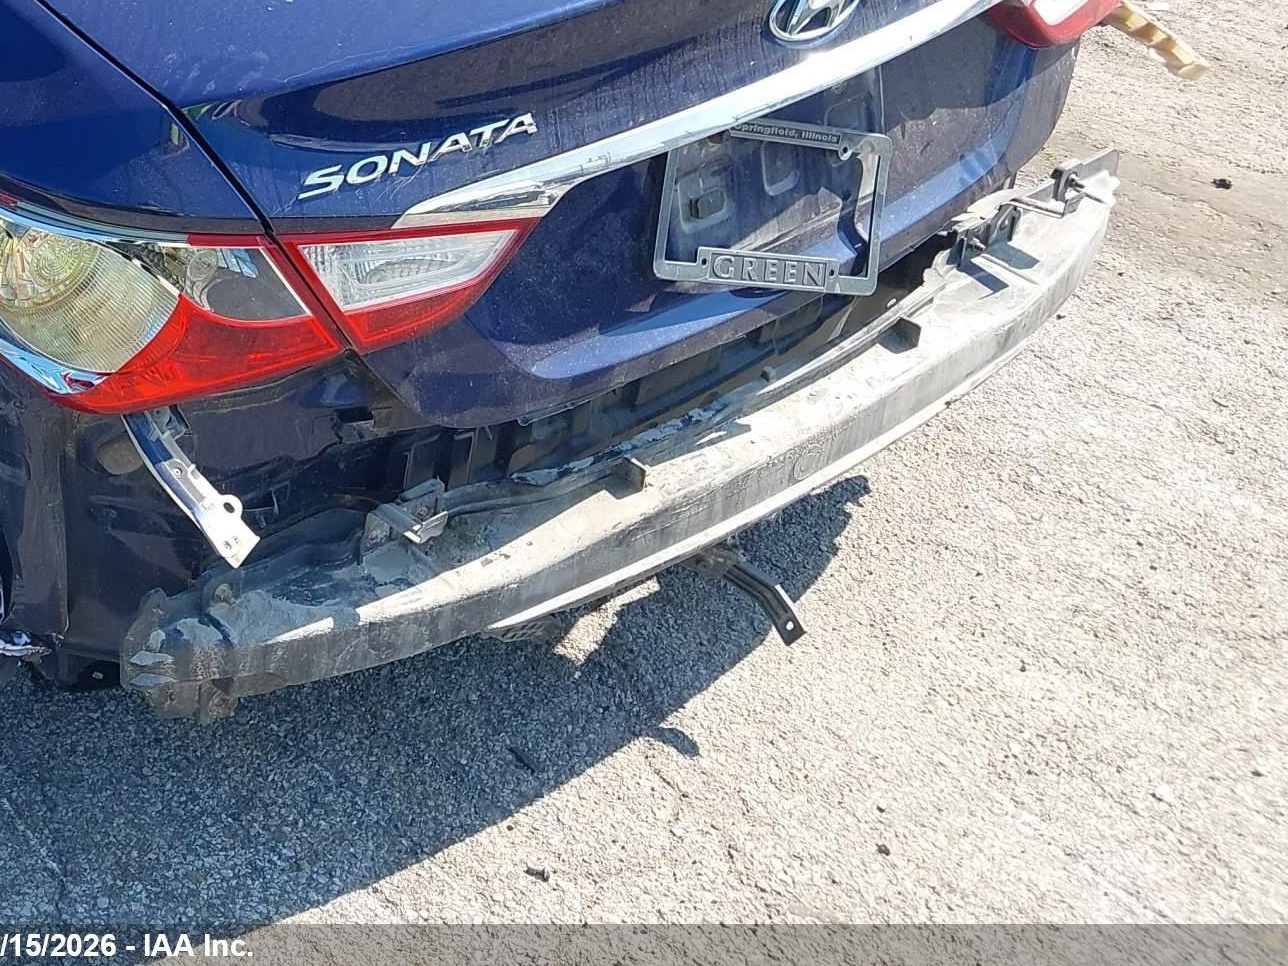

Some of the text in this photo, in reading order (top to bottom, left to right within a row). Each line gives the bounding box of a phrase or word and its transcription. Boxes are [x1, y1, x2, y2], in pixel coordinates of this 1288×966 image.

[801, 129, 838, 143] Illinois
[297, 112, 538, 200] SONATA
[712, 255, 826, 287] GREEN
